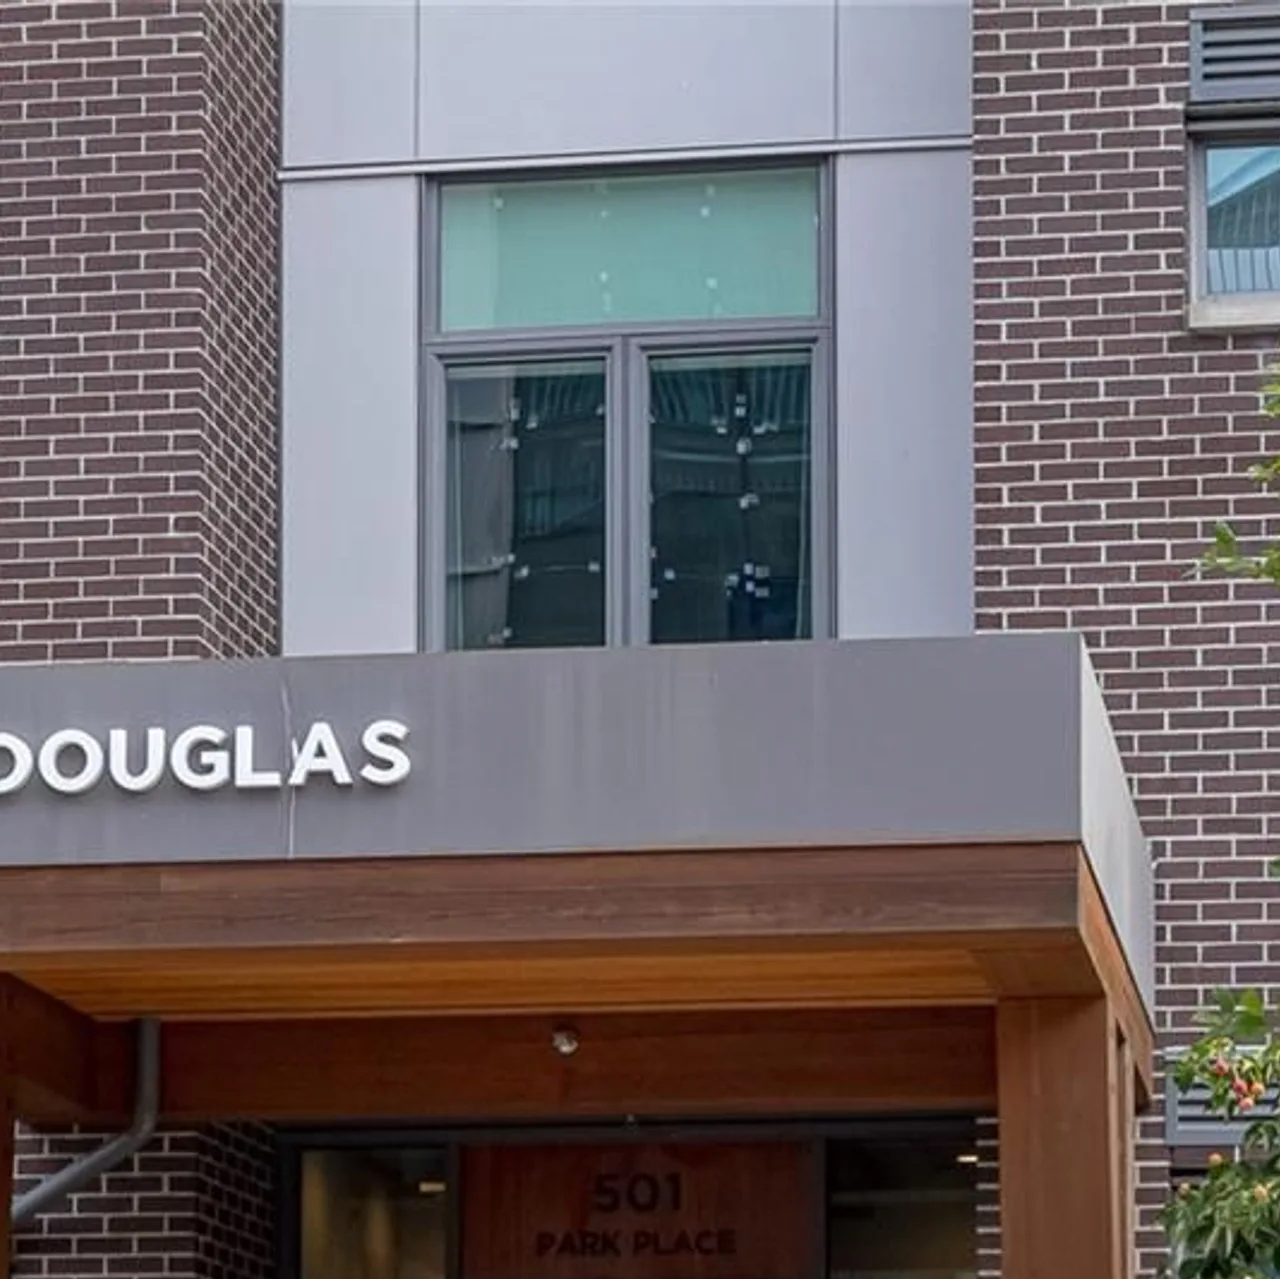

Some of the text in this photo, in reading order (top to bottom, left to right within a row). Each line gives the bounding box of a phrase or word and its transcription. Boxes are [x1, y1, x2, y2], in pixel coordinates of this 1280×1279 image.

[593, 1173, 682, 1213] 501
[535, 1228, 737, 1258] PARK PLACE
